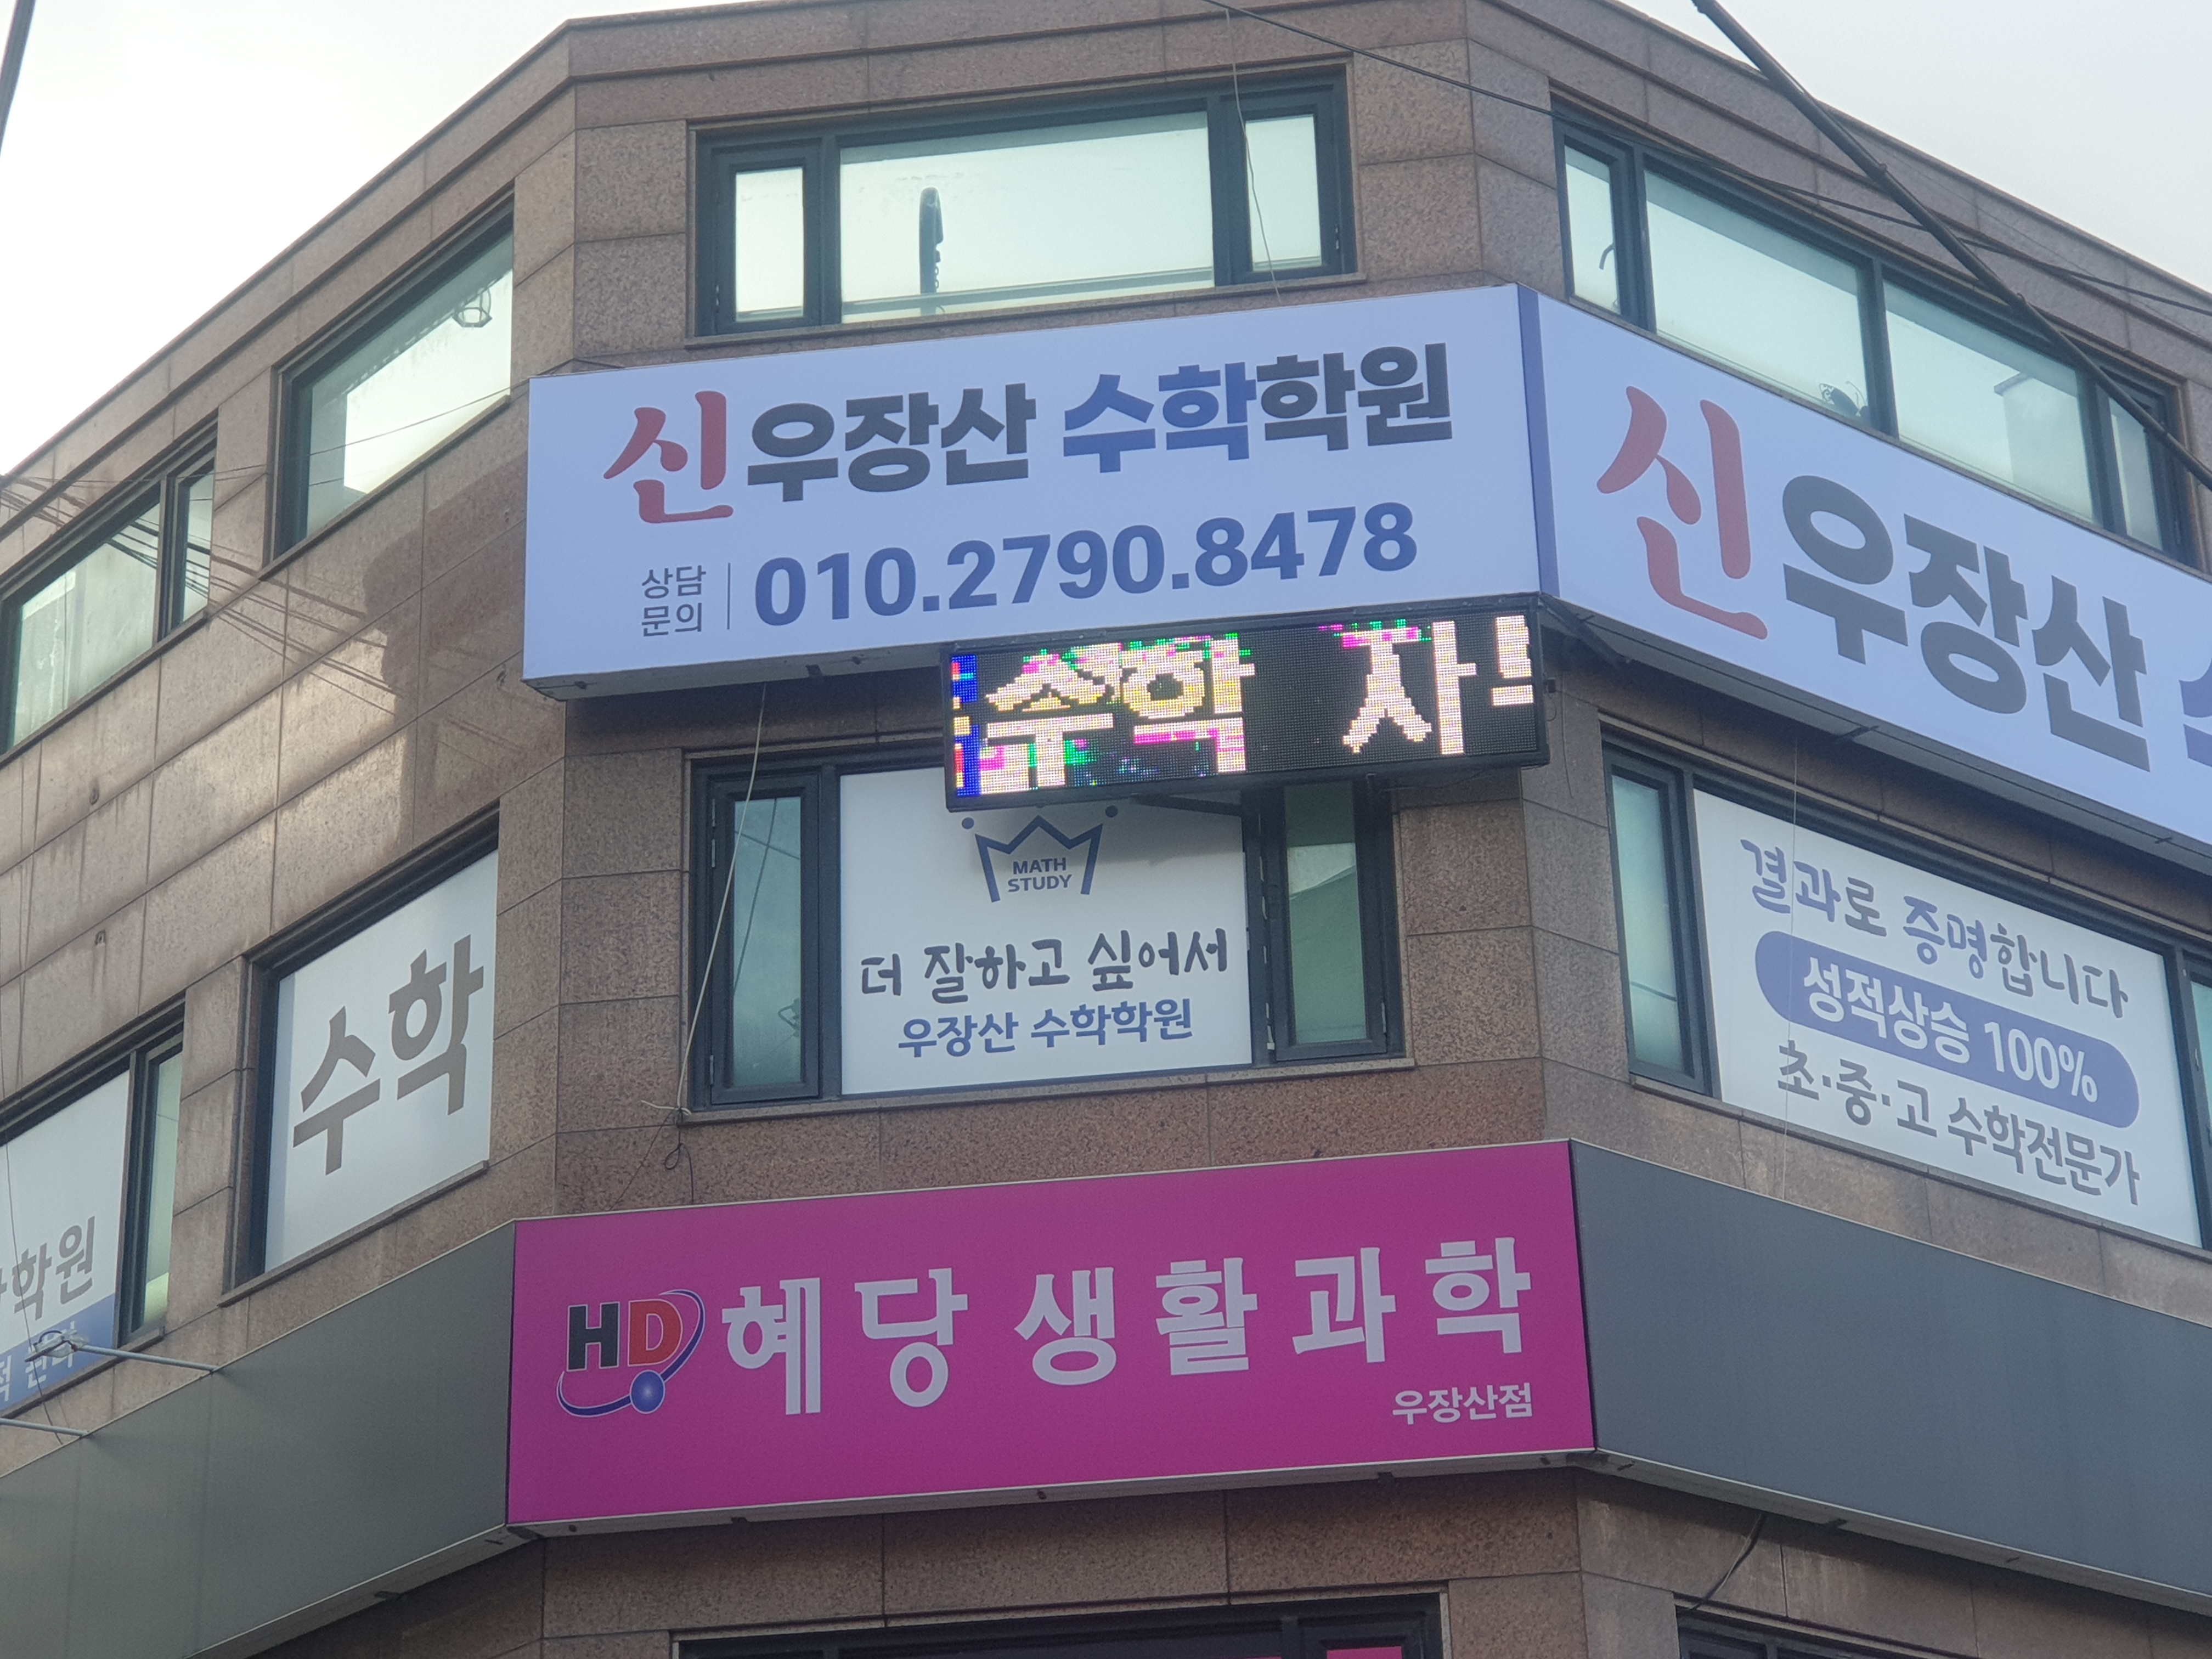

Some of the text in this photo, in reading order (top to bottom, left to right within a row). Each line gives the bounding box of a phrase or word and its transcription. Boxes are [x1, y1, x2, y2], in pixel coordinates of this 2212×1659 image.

[603, 343, 1452, 524] 신우장산 수학학원
[641, 565, 707, 599] 상담
[754, 501, 1417, 626] 010.2790.8478
[1596, 386, 2151, 772] 신우장산
[641, 602, 702, 637] 문의
[1008, 874, 1073, 893] STUDY
[1013, 857, 1066, 874] MATH
[861, 928, 1228, 1004] 더 잘하고 싶어서
[1740, 839, 2129, 1018] 결과로 증명합니다
[292, 934, 484, 1176] 수학
[898, 998, 1193, 1058] 우장산 수학학원
[1803, 956, 2098, 1103] 성적상승 100%
[1947, 1097, 2141, 1206] 수학전문가
[0, 1215, 96, 1321] 학원
[566, 1298, 683, 1372] HD
[721, 1237, 1532, 1415] 혜당 생활과학
[1392, 1381, 1533, 1425] 우장산점
